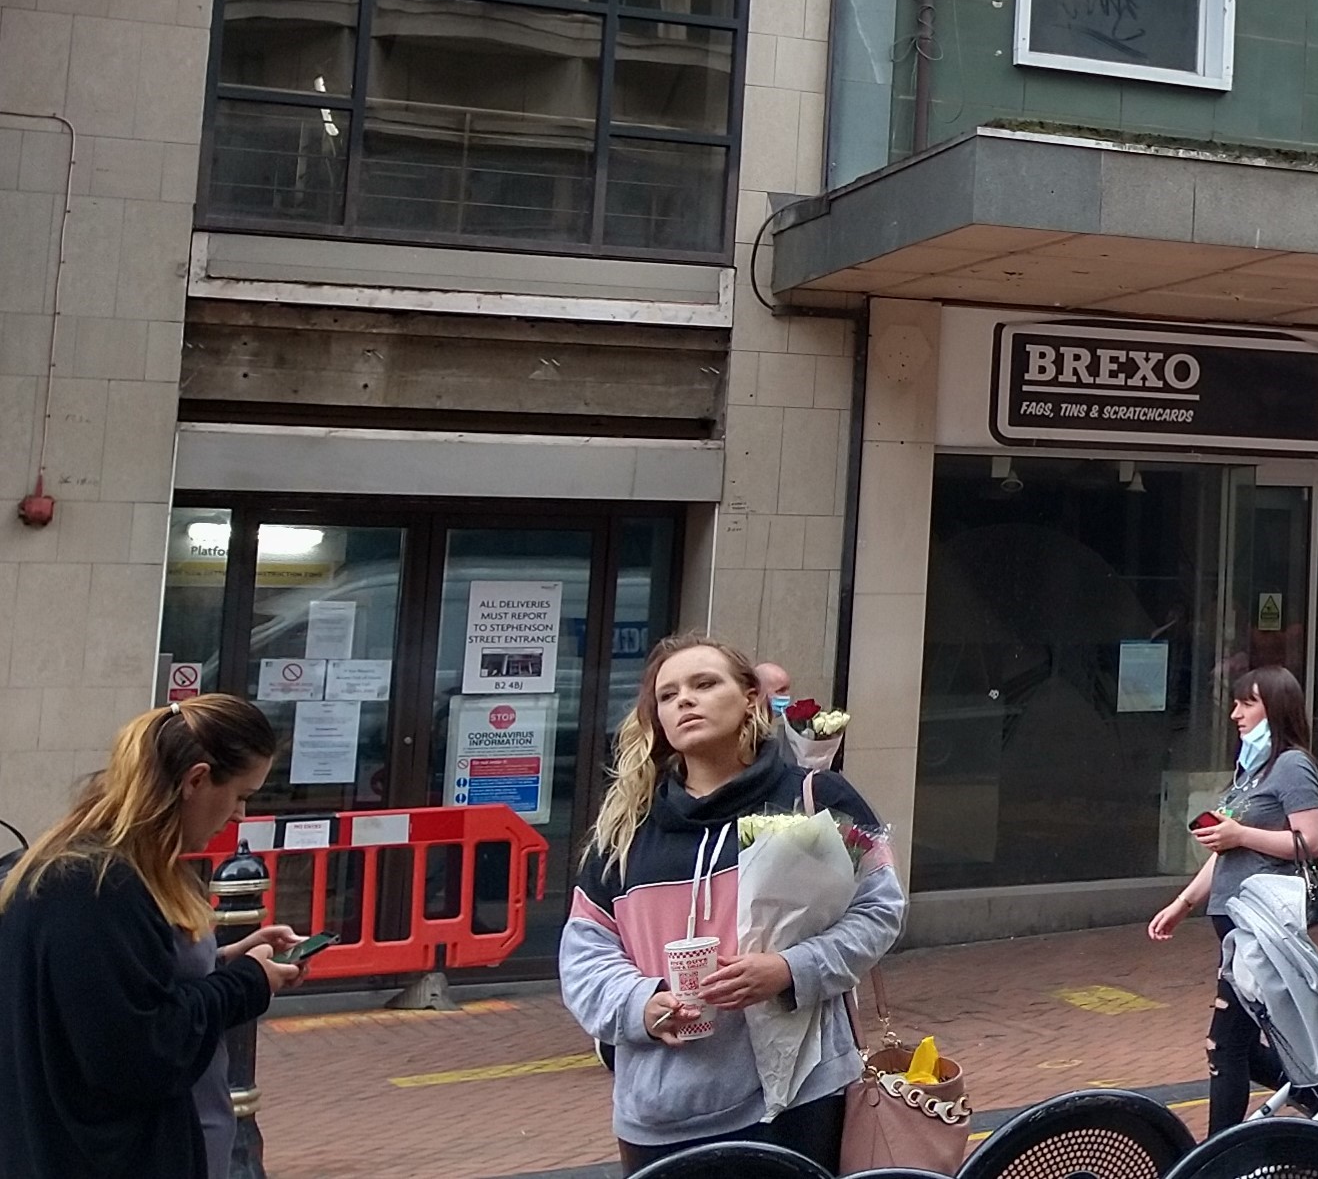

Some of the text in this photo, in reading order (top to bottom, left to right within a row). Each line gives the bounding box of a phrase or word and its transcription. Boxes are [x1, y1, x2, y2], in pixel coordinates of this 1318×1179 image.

[1023, 343, 1201, 390] BREXO
[1020, 401, 1194, 423] FAGS, TINS & SCRATCHCARDS
[190, 545, 228, 556] Platfo
[499, 601, 551, 609] DELIVERIES
[481, 612, 547, 620] MUST REPORT
[505, 635, 557, 643] ENTRANCE
[509, 682, 523, 690] 4BJ
[490, 713, 515, 721] STOP
[467, 731, 534, 740] CORONAVIRUS
[469, 738, 532, 746] INFORMATION
